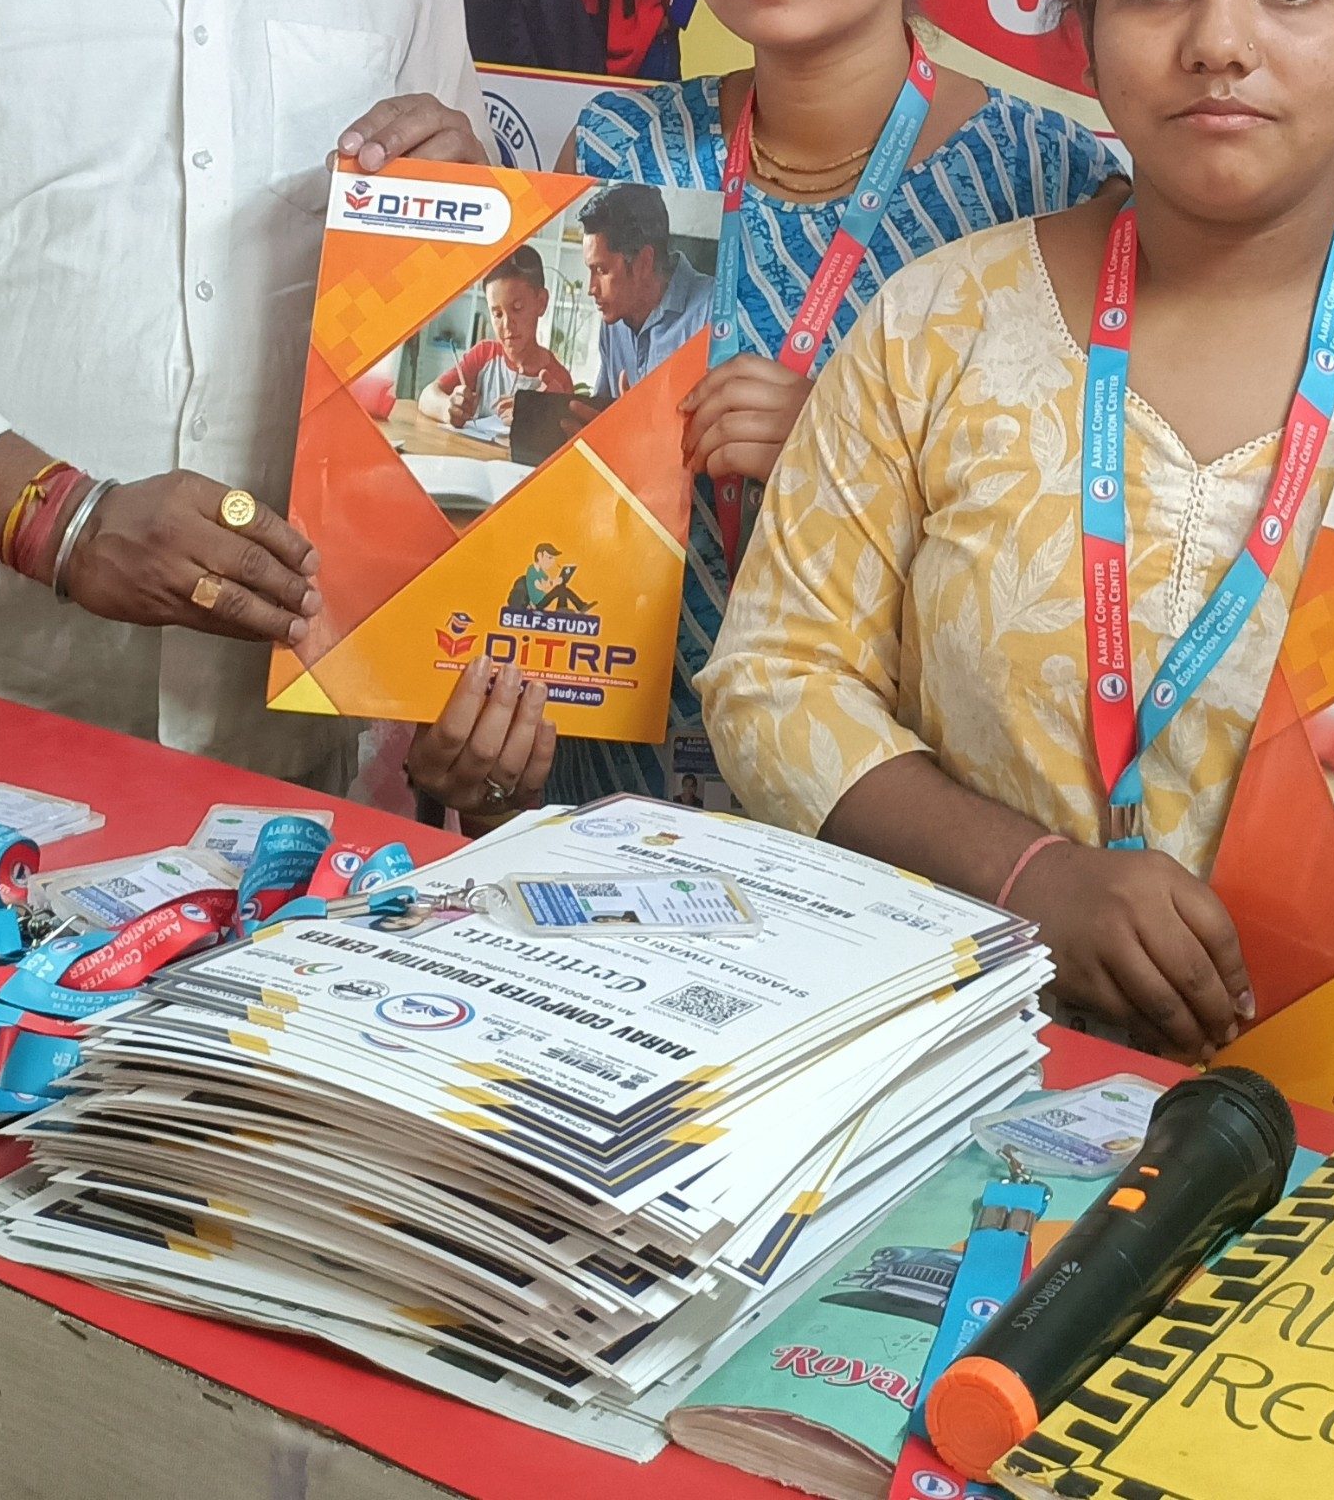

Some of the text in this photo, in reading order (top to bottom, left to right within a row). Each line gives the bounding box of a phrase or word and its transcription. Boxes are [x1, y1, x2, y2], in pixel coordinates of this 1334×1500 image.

[868, 114, 907, 186] AARAV COMPUTER
[877, 117, 916, 193] EDUCATION CENTER
[378, 194, 483, 222] DiTRP
[801, 252, 842, 327] AARAV COMPUTER
[810, 254, 856, 333] EDUCATION CENTER
[1103, 220, 1123, 303] AARAV COMPUTER
[1116, 218, 1134, 306] EDUCATION CENTER
[1318, 306, 1333, 343] AARAV
[1091, 378, 1105, 470] AARAV COMPUTER
[1104, 374, 1119, 473] EDUCATION CENTER
[1272, 421, 1305, 510] AARAV COMPUTER
[1280, 424, 1320, 521] EDUCATION CENTER
[485, 632, 637, 676] DiTRP
[502, 612, 599, 635] SELF-STUDY
[1094, 562, 1110, 667] AARAV COMPUTER
[1108, 558, 1126, 671] EDUCATION CENTER
[1167, 588, 1234, 678] AARAV COMPUTER
[1176, 595, 1248, 687] EDUCATION CENTER
[67, 907, 178, 981] EDUCATION CENTER
[78, 921, 183, 992] AARAV COMPUTER
[296, 929, 697, 1061] AARAV COMPUTER EDUCATION CENTER
[591, 998, 615, 1010] ISO
[1012, 1267, 1072, 1331] ZEBRONICS
